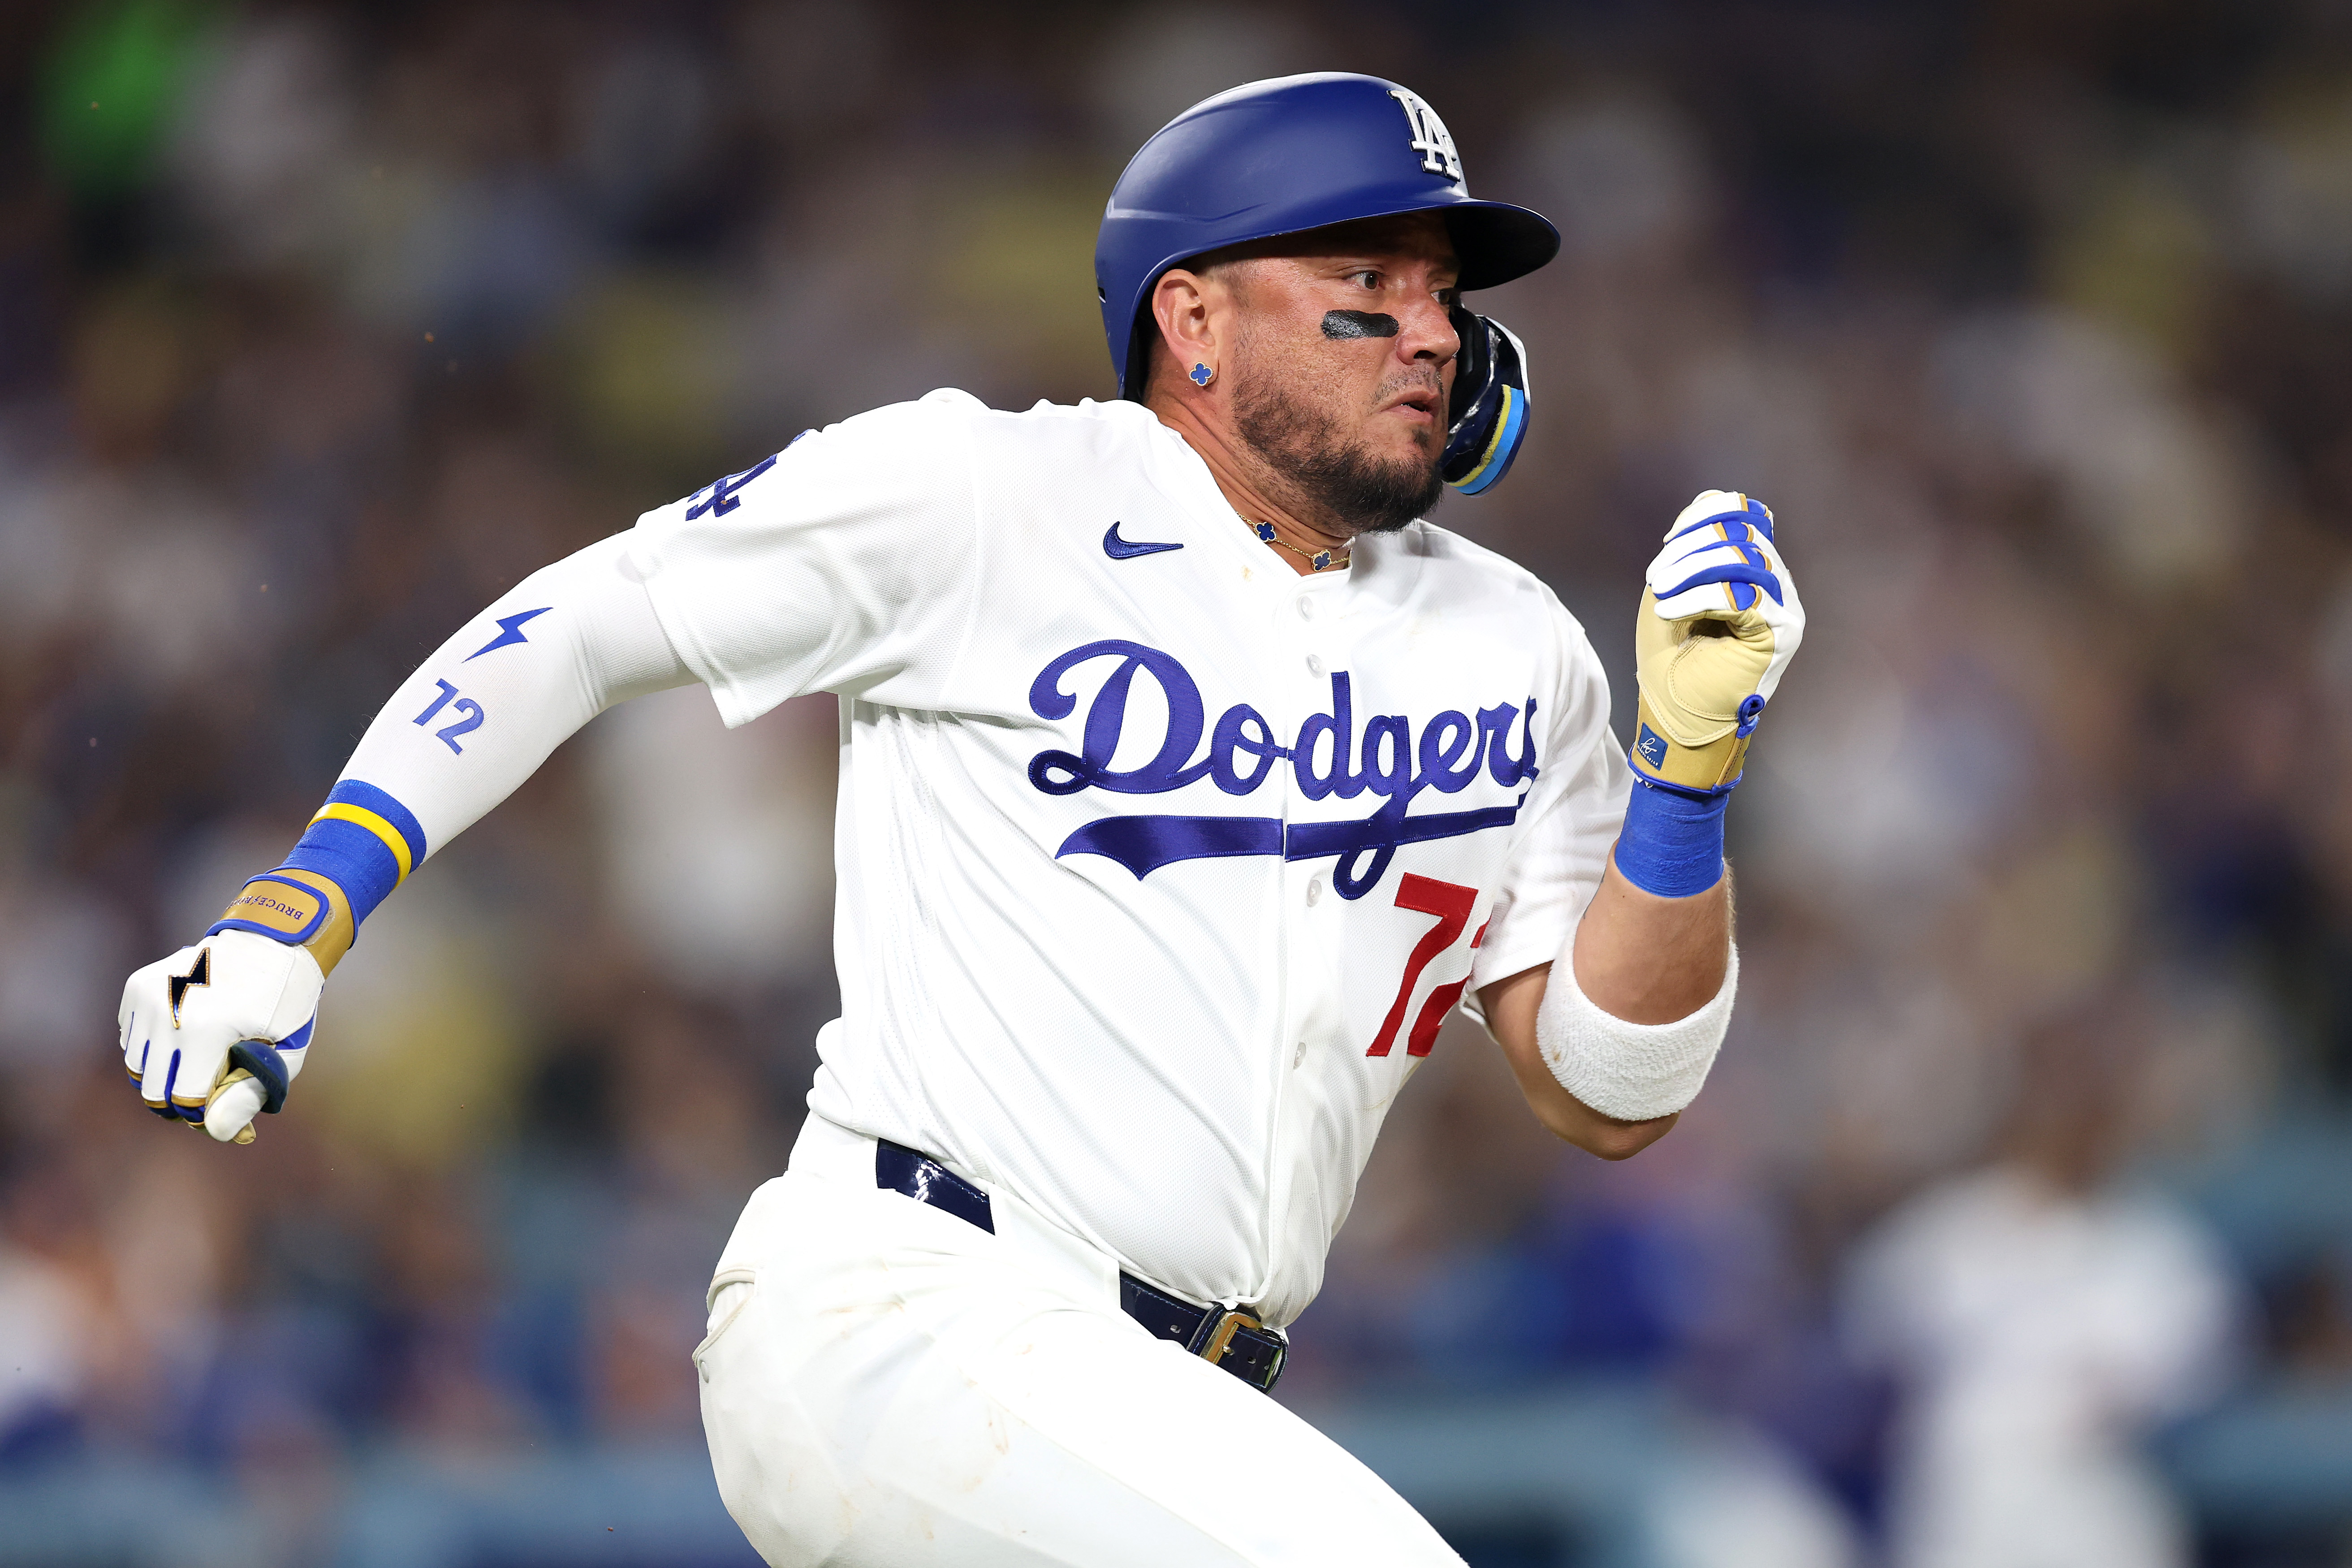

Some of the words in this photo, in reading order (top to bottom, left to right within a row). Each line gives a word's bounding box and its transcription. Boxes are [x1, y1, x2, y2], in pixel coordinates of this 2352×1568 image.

[1386, 89, 1460, 182] LA
[413, 678, 484, 755] 72
[1028, 639, 1540, 900] Dodgers
[258, 897, 304, 920] BRUCE
